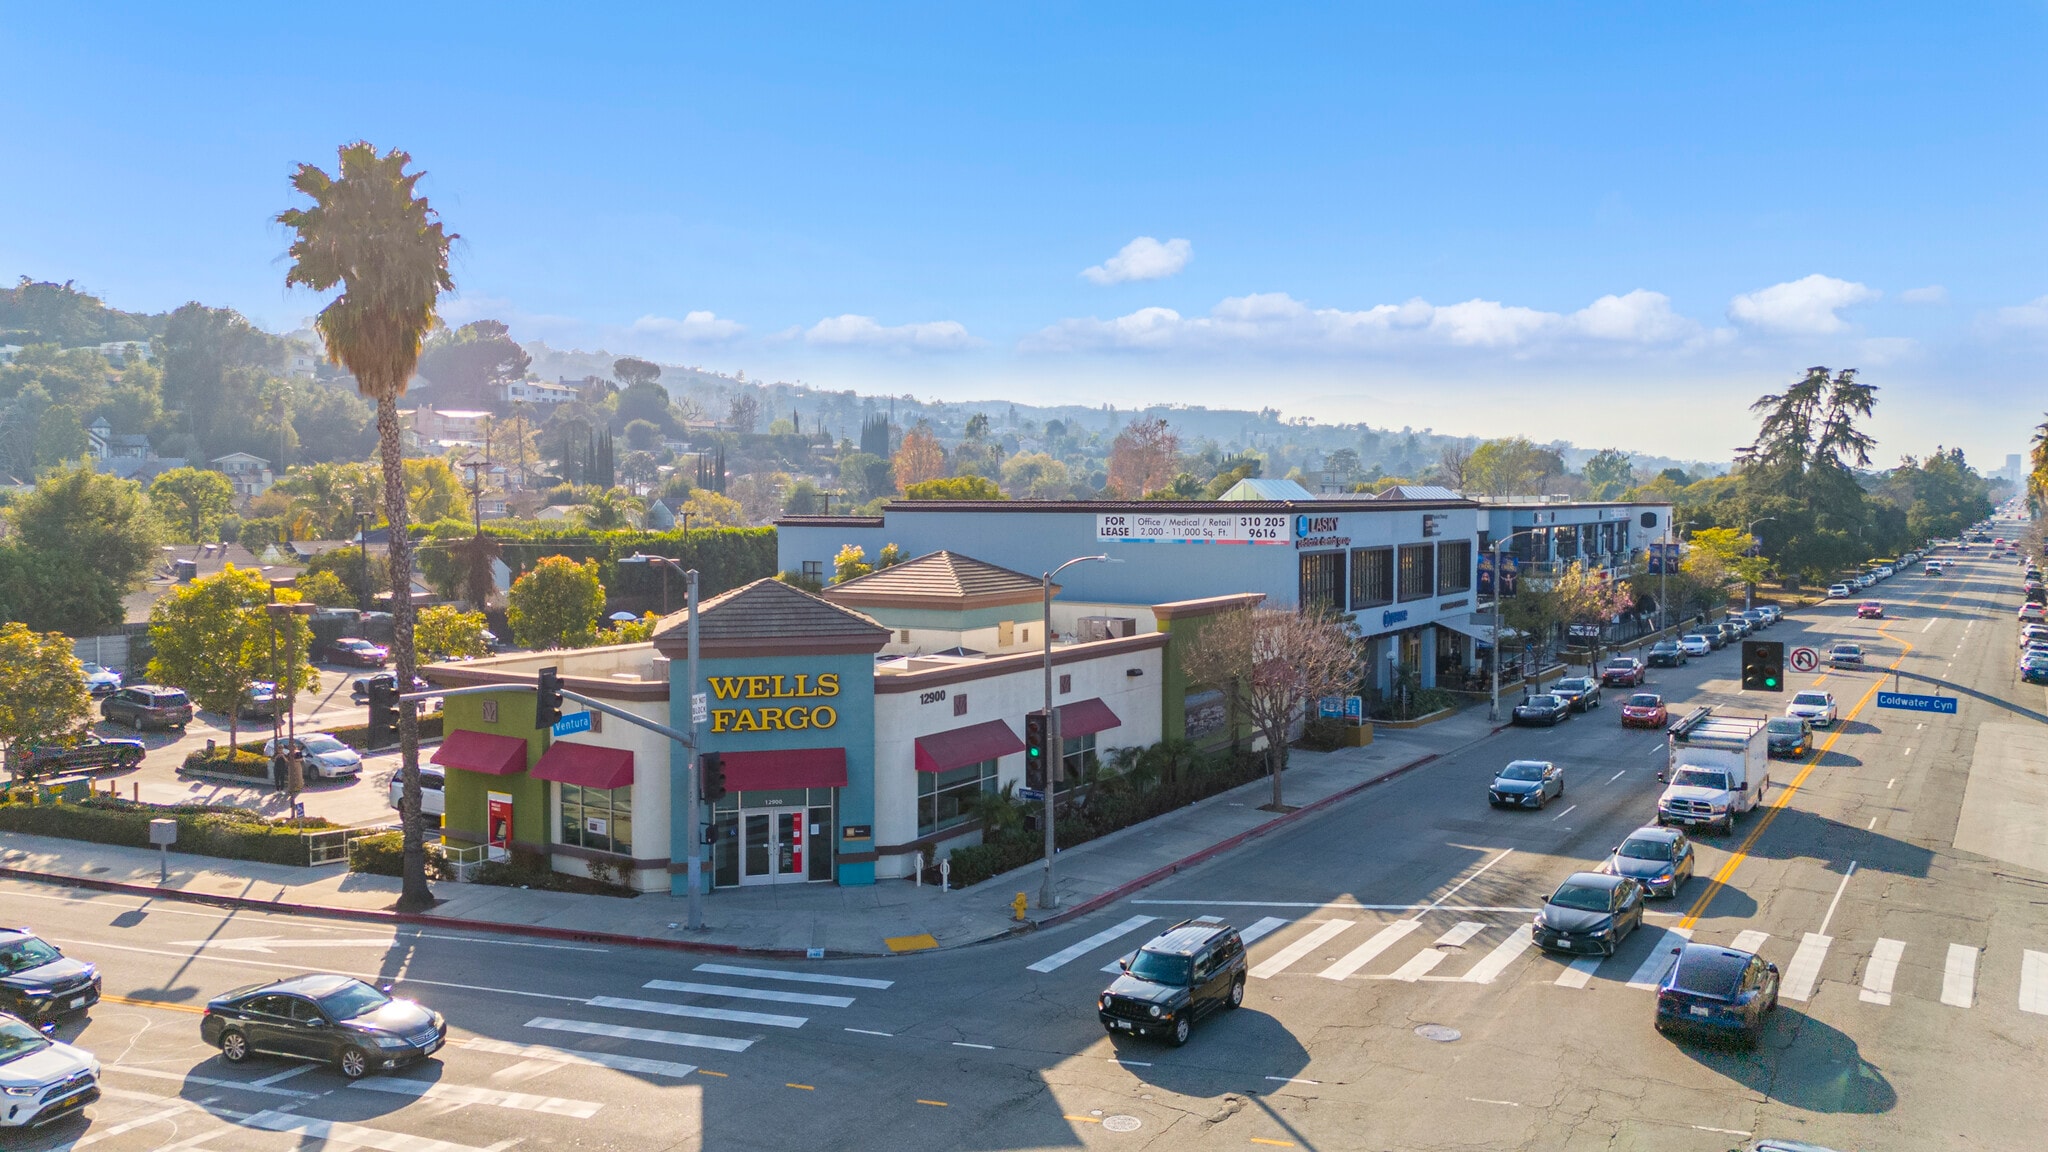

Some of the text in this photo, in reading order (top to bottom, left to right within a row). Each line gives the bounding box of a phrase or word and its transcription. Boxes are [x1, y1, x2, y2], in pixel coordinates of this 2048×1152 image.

[1105, 517, 1125, 526] FOR
[1137, 517, 1161, 526] Office
[1169, 518, 1200, 526] Medical
[1209, 518, 1232, 527] Retail
[1240, 517, 1285, 527] 310 205
[1308, 518, 1339, 532] LASKY
[1100, 527, 1130, 537] LEASE
[1140, 527, 1164, 537] 2,000
[1171, 528, 1200, 537] 11,000
[1202, 528, 1216, 538] Sq.
[1218, 528, 1228, 537] Ft.
[1248, 529, 1277, 538] 9616
[707, 673, 840, 700] WELLS
[919, 690, 946, 705] 12900
[1880, 695, 1953, 711] Coldwater Cyn
[555, 716, 589, 732] Ventura
[710, 705, 838, 733] FARGO
